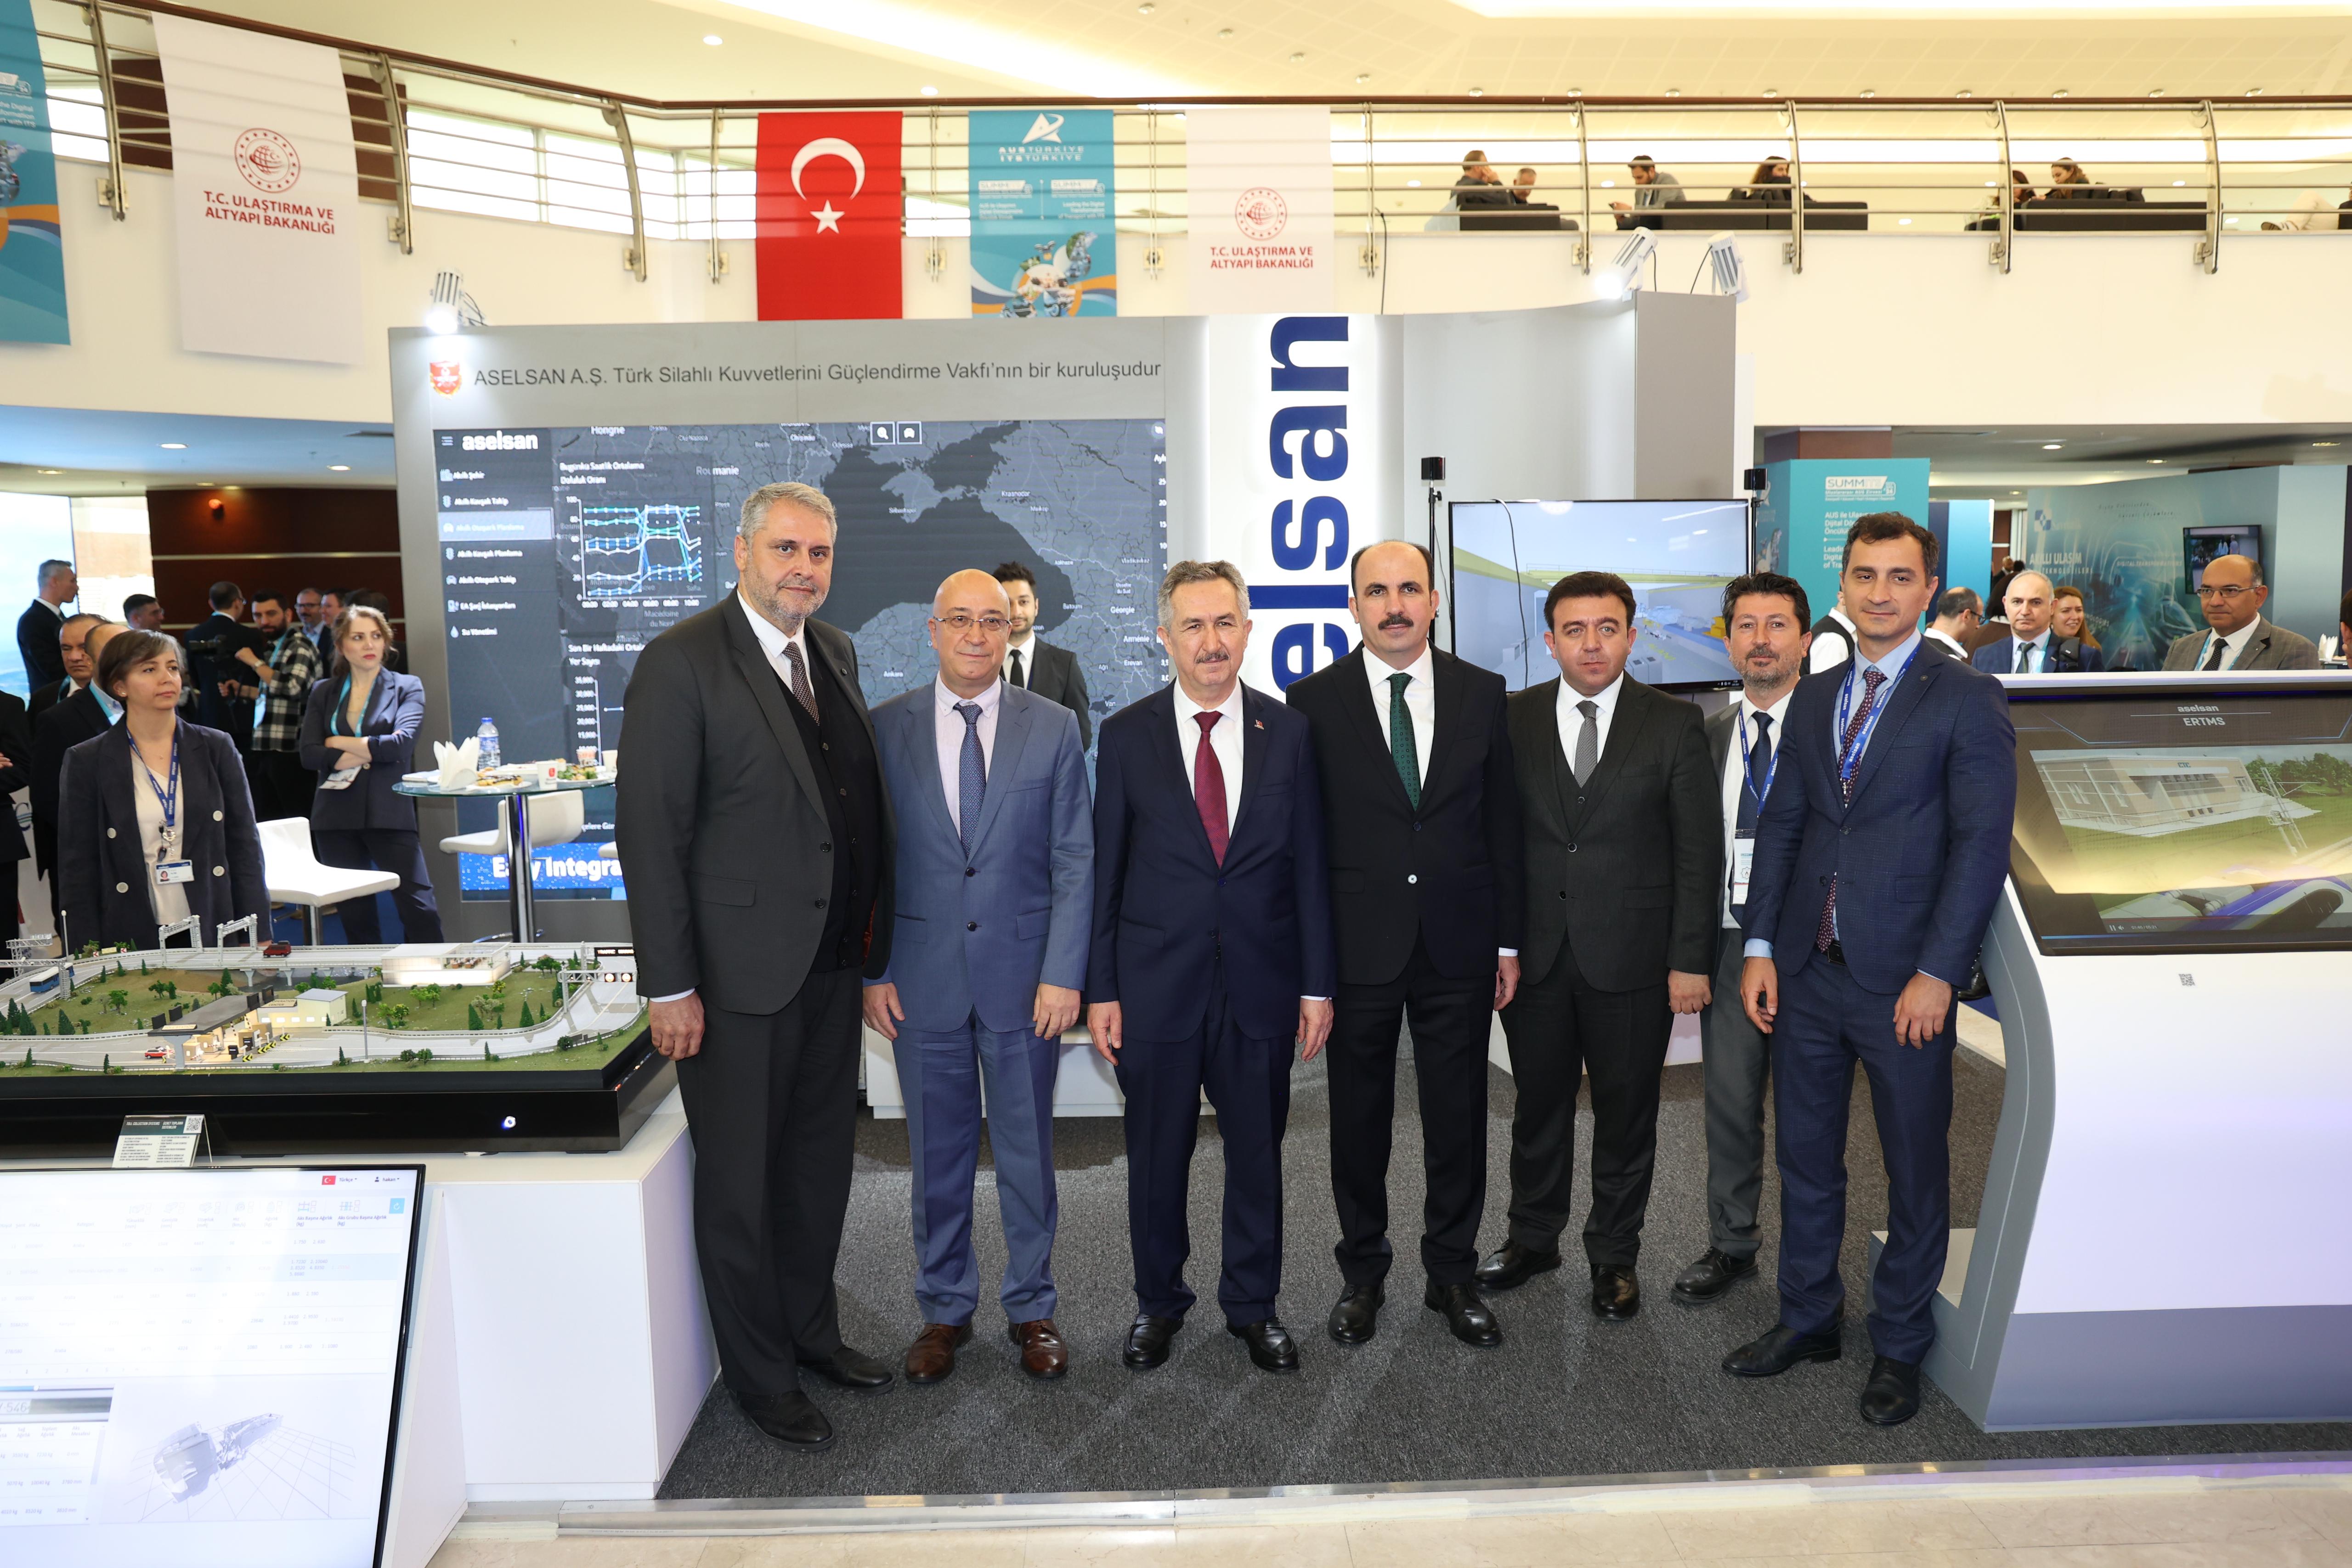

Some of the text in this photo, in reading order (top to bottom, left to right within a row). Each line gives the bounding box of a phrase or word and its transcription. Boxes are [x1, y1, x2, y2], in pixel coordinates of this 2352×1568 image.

[204, 191, 334, 220] T.C. ULAŞTIRMA VE
[205, 207, 335, 234] ALTYAPI BAKANLIĞI
[1210, 246, 1313, 258] T.C. ULAŞTIRMA VE
[1211, 258, 1313, 268] ALTYAPI BAKANLIĞI
[474, 361, 1161, 388] ASELSAN A.Ş. Türk Silahlı Kuvvetlerini Güçlendirme Vakfı'nın bir kuruluşudur
[462, 430, 538, 450] aselsan
[696, 465, 739, 475] Roumanie
[1249, 316, 1349, 695] elsan
[1110, 606, 1135, 615] Géorgie
[1862, 716, 1874, 735] aselsan
[2183, 717, 2226, 726] ERTMS
[1849, 743, 1860, 762] aselsan
[492, 856, 623, 881] Ey Integra
